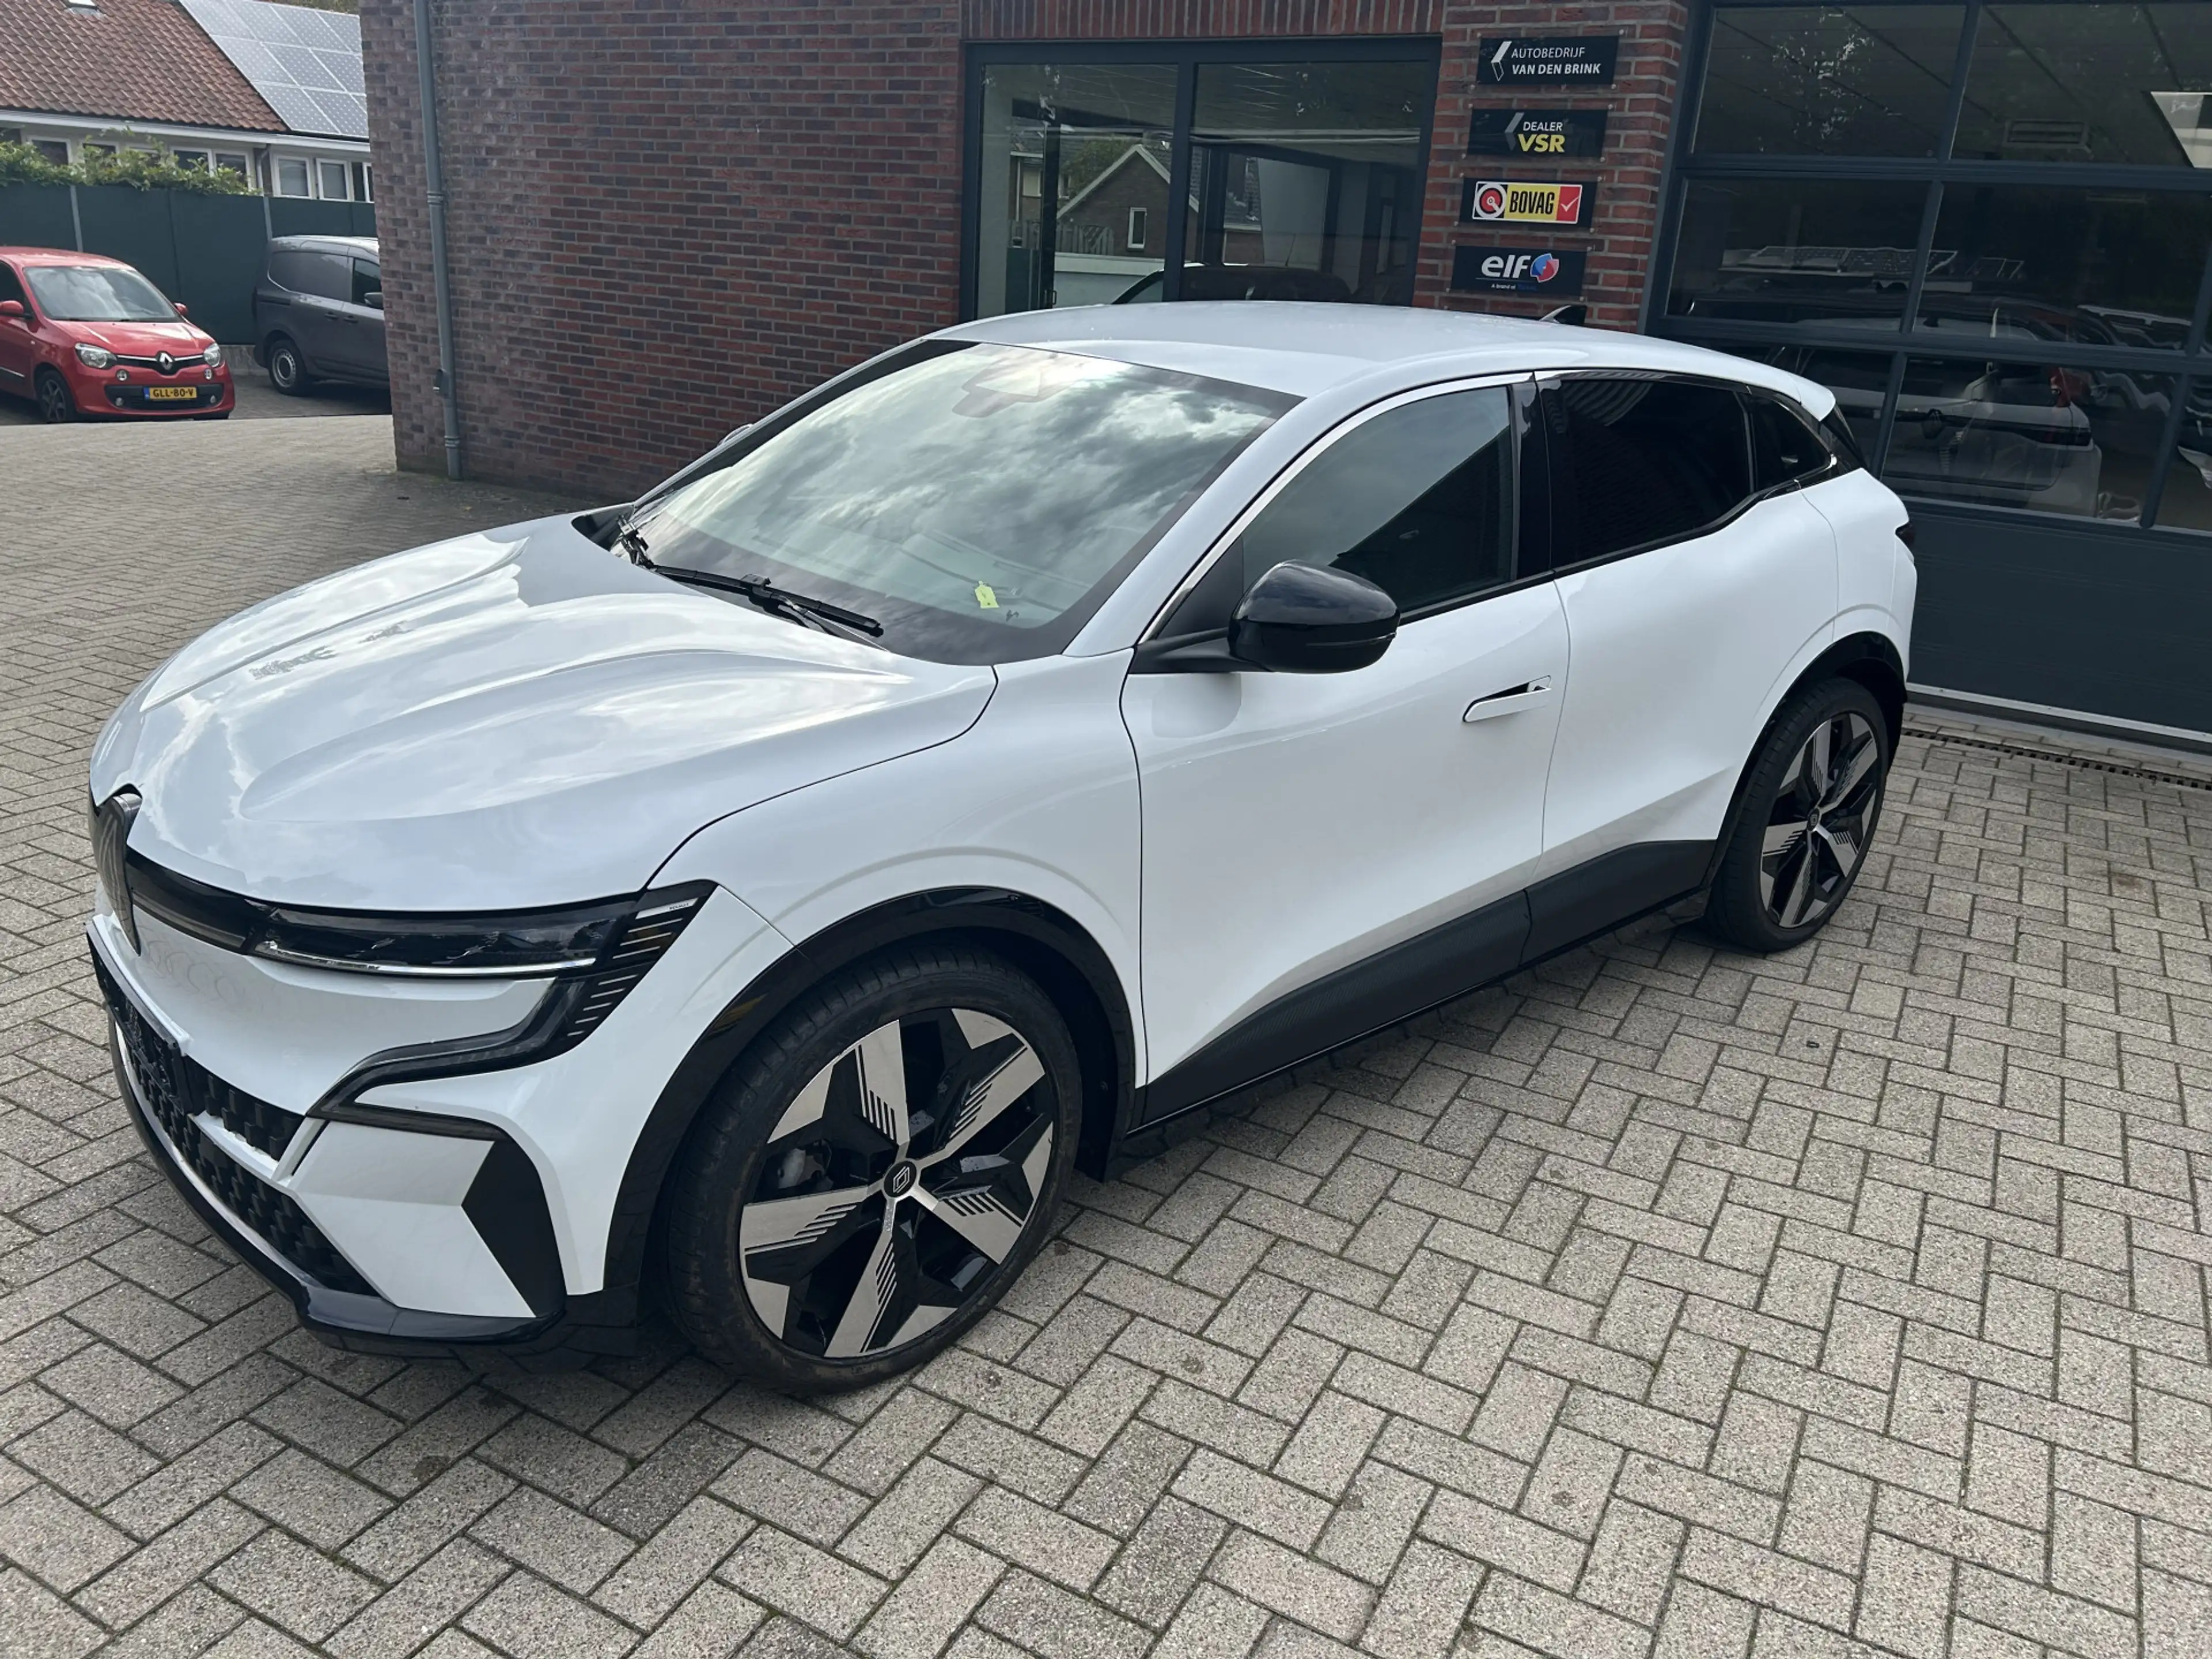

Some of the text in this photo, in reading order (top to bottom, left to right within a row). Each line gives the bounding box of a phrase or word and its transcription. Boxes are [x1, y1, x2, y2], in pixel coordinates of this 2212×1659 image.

[1511, 47, 1585, 59] AUTOBEDRIJF
[1512, 63, 1601, 75] VAN DEN BRINK
[1522, 122, 1563, 132] DEALER
[1517, 133, 1566, 153] VSR
[1509, 191, 1555, 215] BOVAG
[1481, 254, 1532, 279] elf
[153, 388, 194, 397] GLL-80-V
